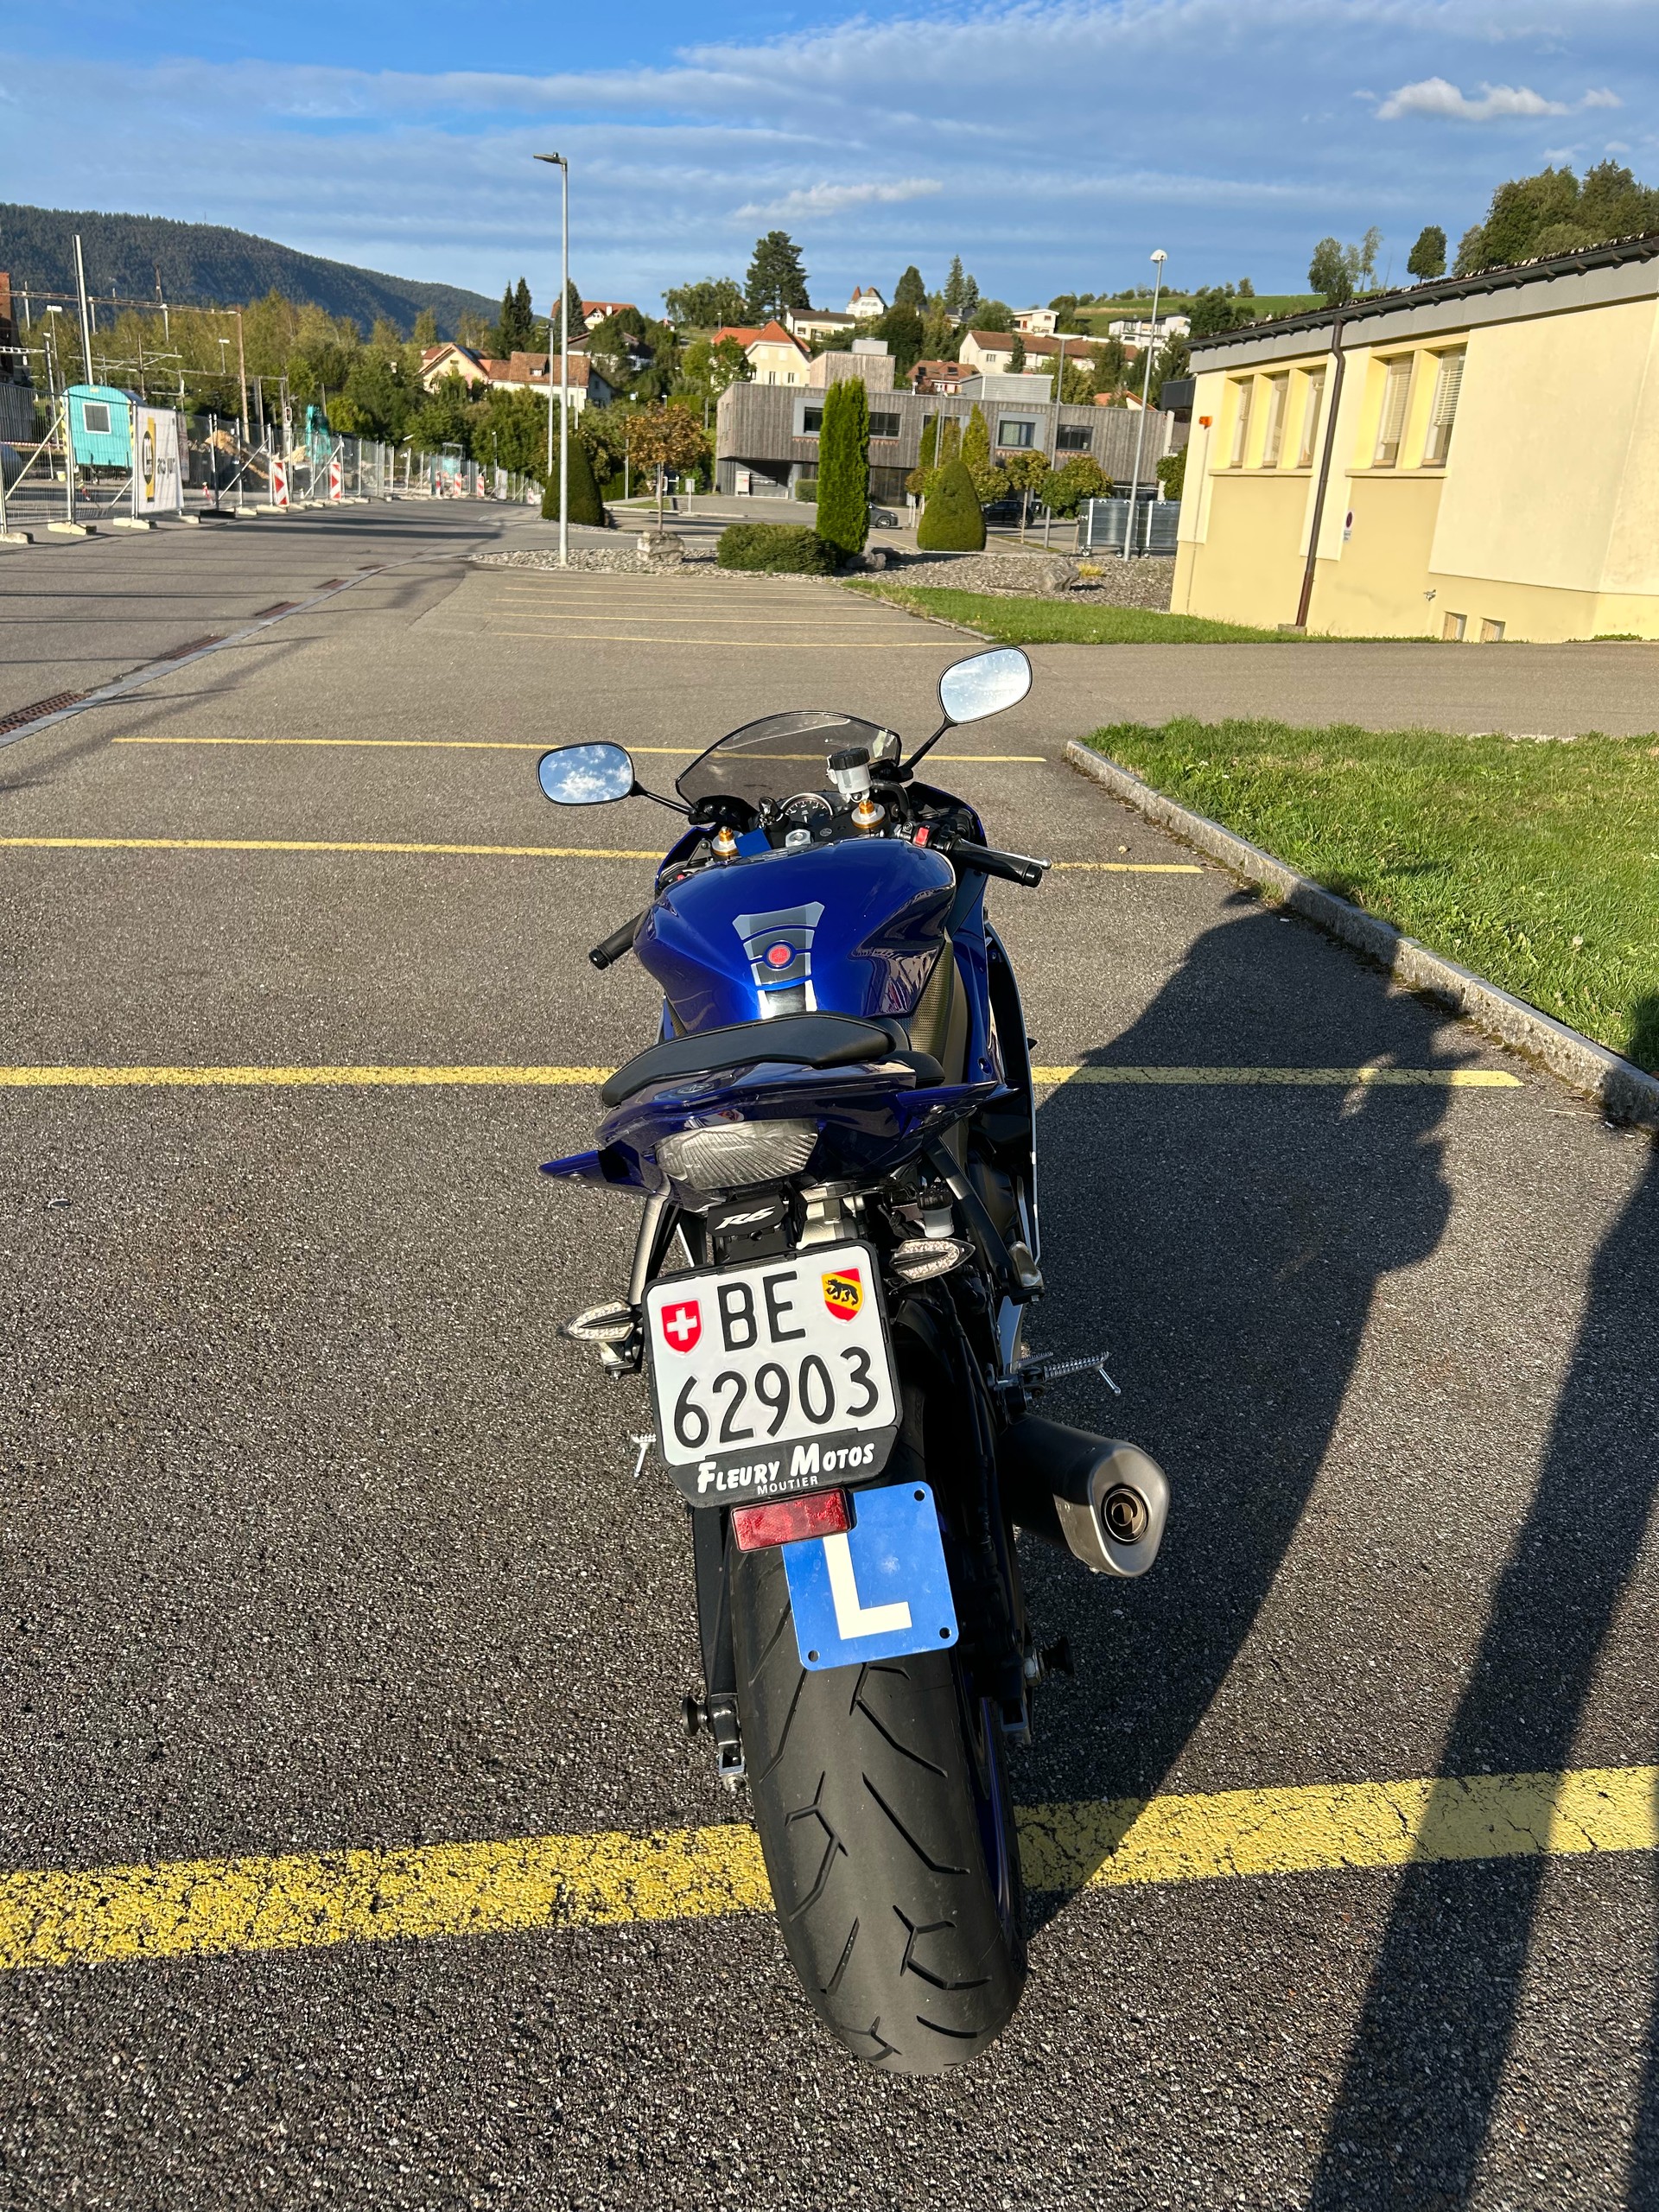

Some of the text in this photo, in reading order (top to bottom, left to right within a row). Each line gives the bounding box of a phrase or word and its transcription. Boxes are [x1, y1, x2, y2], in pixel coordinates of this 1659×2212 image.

[715, 1205, 776, 1230] R6
[716, 1270, 806, 1352] BE
[673, 1346, 880, 1449] 62903
[696, 1442, 875, 1494] FLEURY MOTOS
[757, 1475, 819, 1496] MOUTIER
[823, 1532, 912, 1640] L
